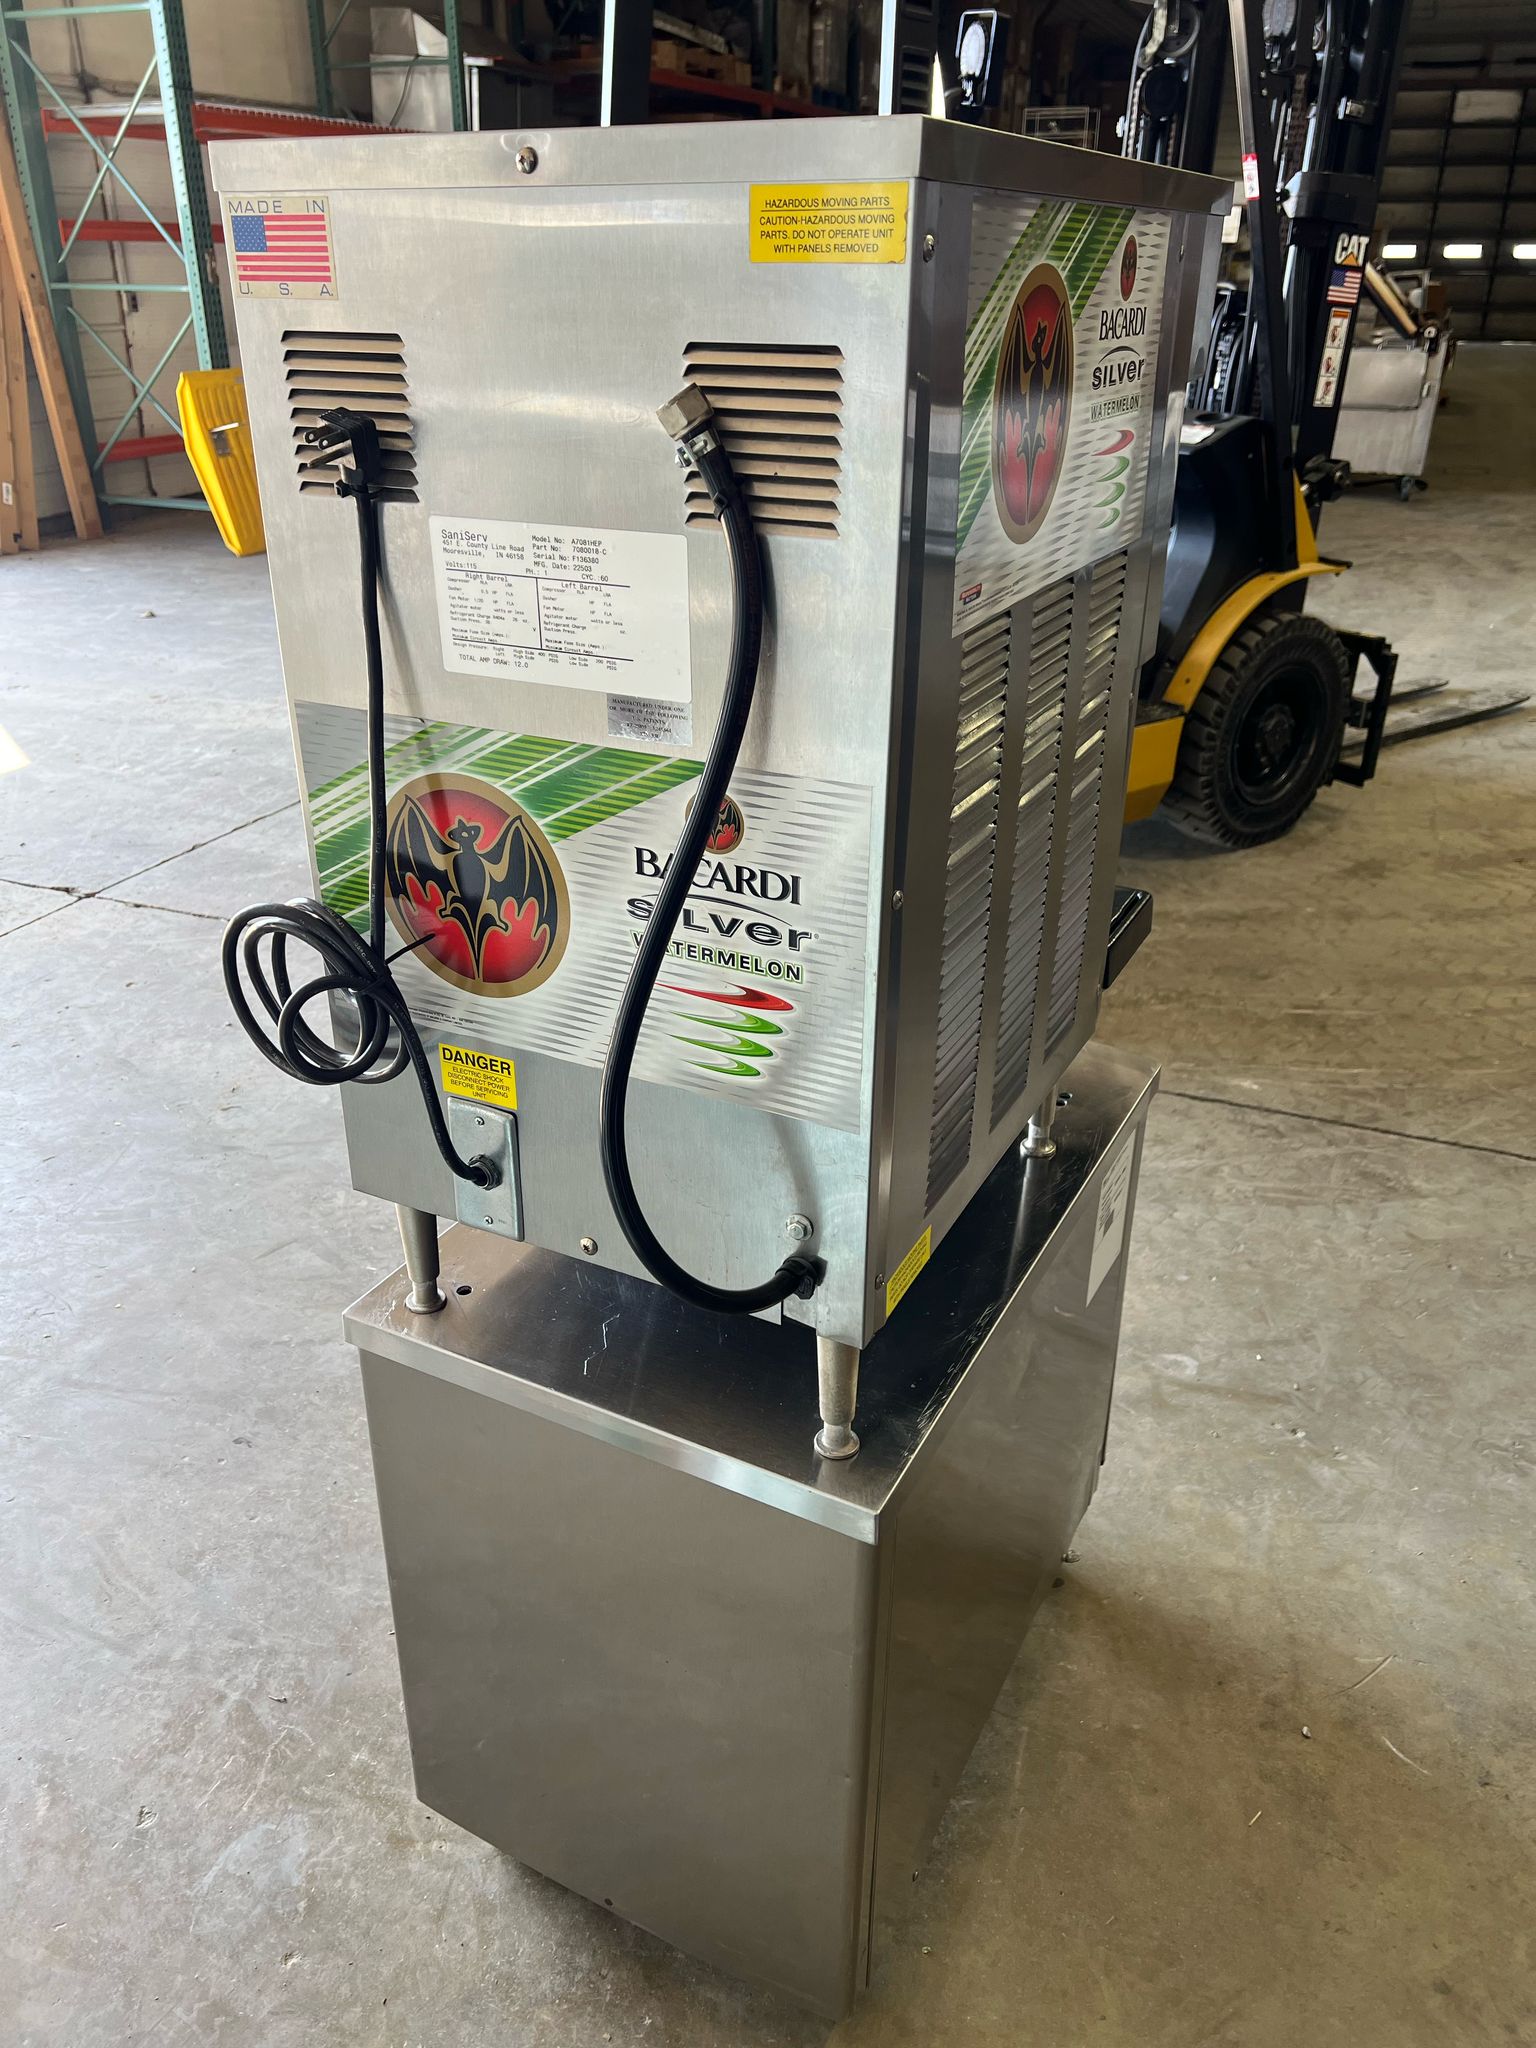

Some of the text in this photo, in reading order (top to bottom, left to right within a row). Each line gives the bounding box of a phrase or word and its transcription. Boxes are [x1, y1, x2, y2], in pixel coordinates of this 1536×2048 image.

[228, 199, 325, 213] MADE IN
[765, 196, 890, 209] HAZARDOUS MOVING PARTS
[760, 213, 895, 226] CAUTION-HAZARDOUS MOVING
[760, 229, 894, 239] PARTS. DO NOT OPERATE UNIT
[774, 243, 879, 253] WITH PANELS REMOVED
[1335, 233, 1369, 267] CAT
[1098, 306, 1147, 341] BACARDI
[1090, 395, 1139, 421] WATERMELON
[441, 529, 488, 542] SaniServ
[531, 534, 551, 543] Model
[554, 536, 565, 544] No:
[466, 541, 489, 550] County
[509, 544, 525, 552] Road
[532, 543, 547, 551] Part
[443, 547, 485, 558] Mooresville,
[505, 552, 525, 560] 46158
[533, 552, 555, 560] Serial
[533, 561, 592, 572] MFG. Date: 22503
[465, 573, 508, 583] Right Barrel
[561, 582, 603, 592] Left Barrel
[459, 653, 476, 662] TOTAL
[514, 661, 529, 669] 12.0
[442, 1047, 511, 1076] DANGER
[448, 1072, 510, 1091] DISCONNECT POWER
[452, 1067, 504, 1083] ELECTRIC SHOCK
[450, 1079, 508, 1098] BEFORE SERVICING
